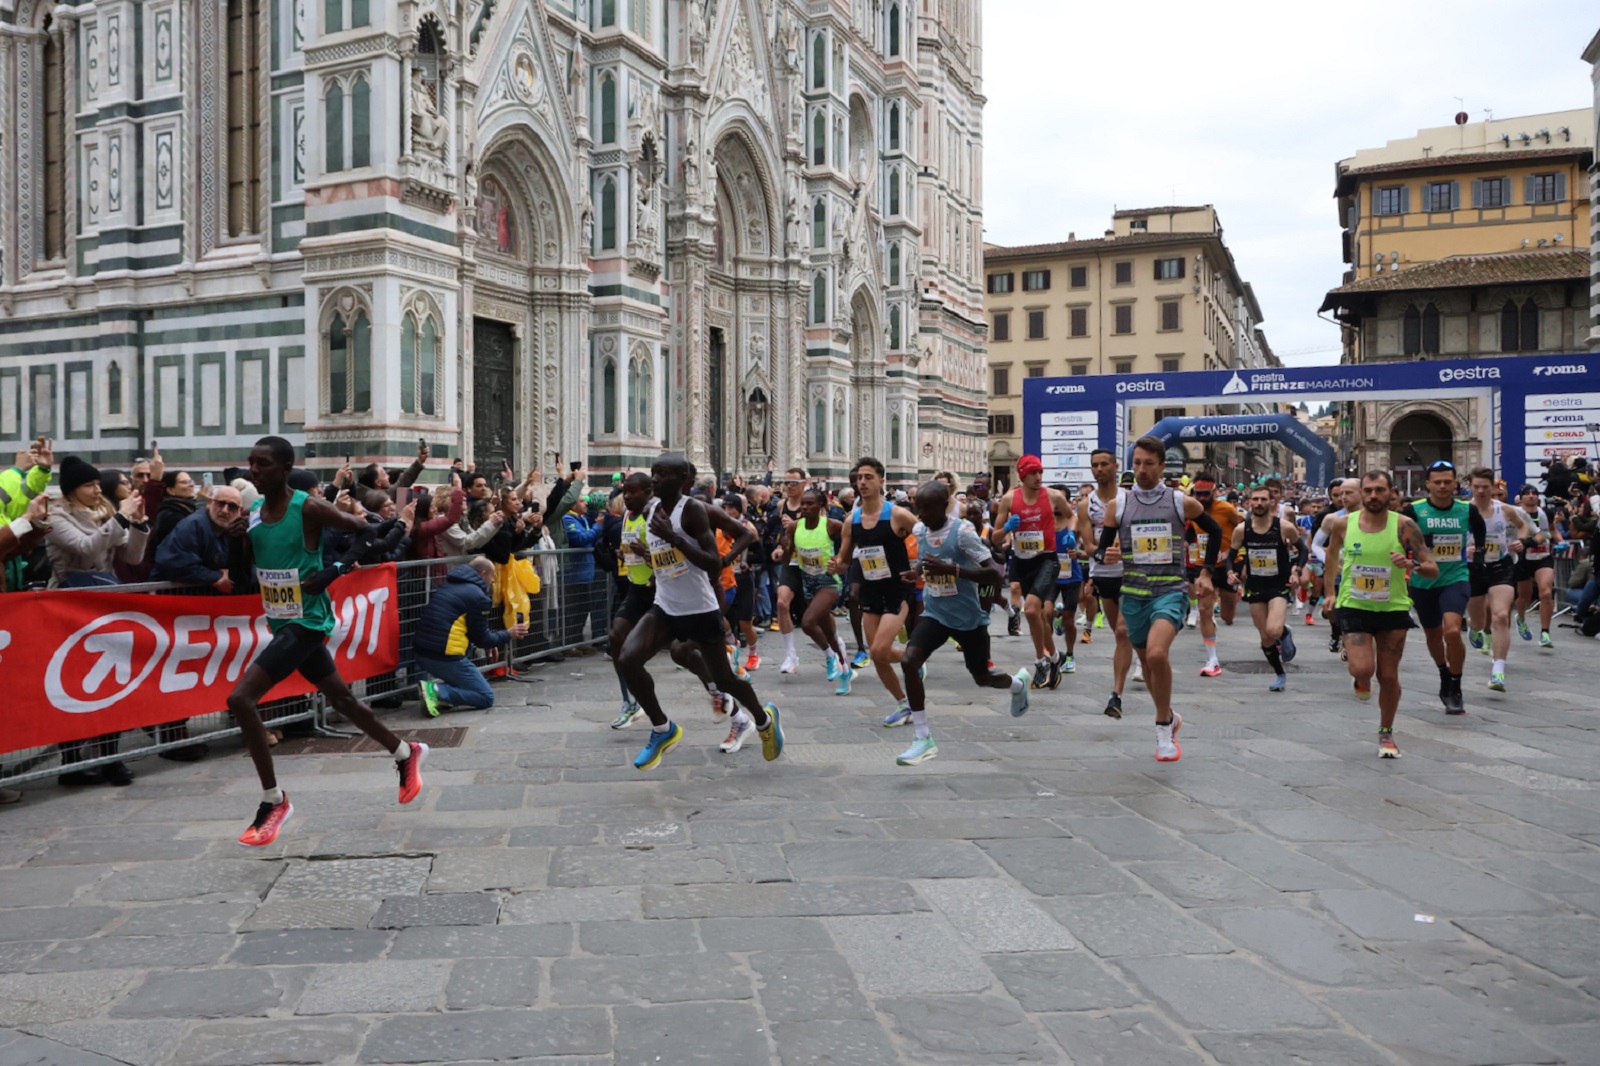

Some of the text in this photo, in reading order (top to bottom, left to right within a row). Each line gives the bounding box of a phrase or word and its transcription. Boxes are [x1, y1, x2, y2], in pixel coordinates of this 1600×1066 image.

[1261, 373, 1285, 382] estra
[1453, 366, 1501, 380] estra
[1127, 379, 1165, 392] estra
[1553, 398, 1583, 406] estra
[1427, 518, 1462, 529] BRASIL
[1146, 538, 1158, 551] 35
[1365, 578, 1375, 590] 19
